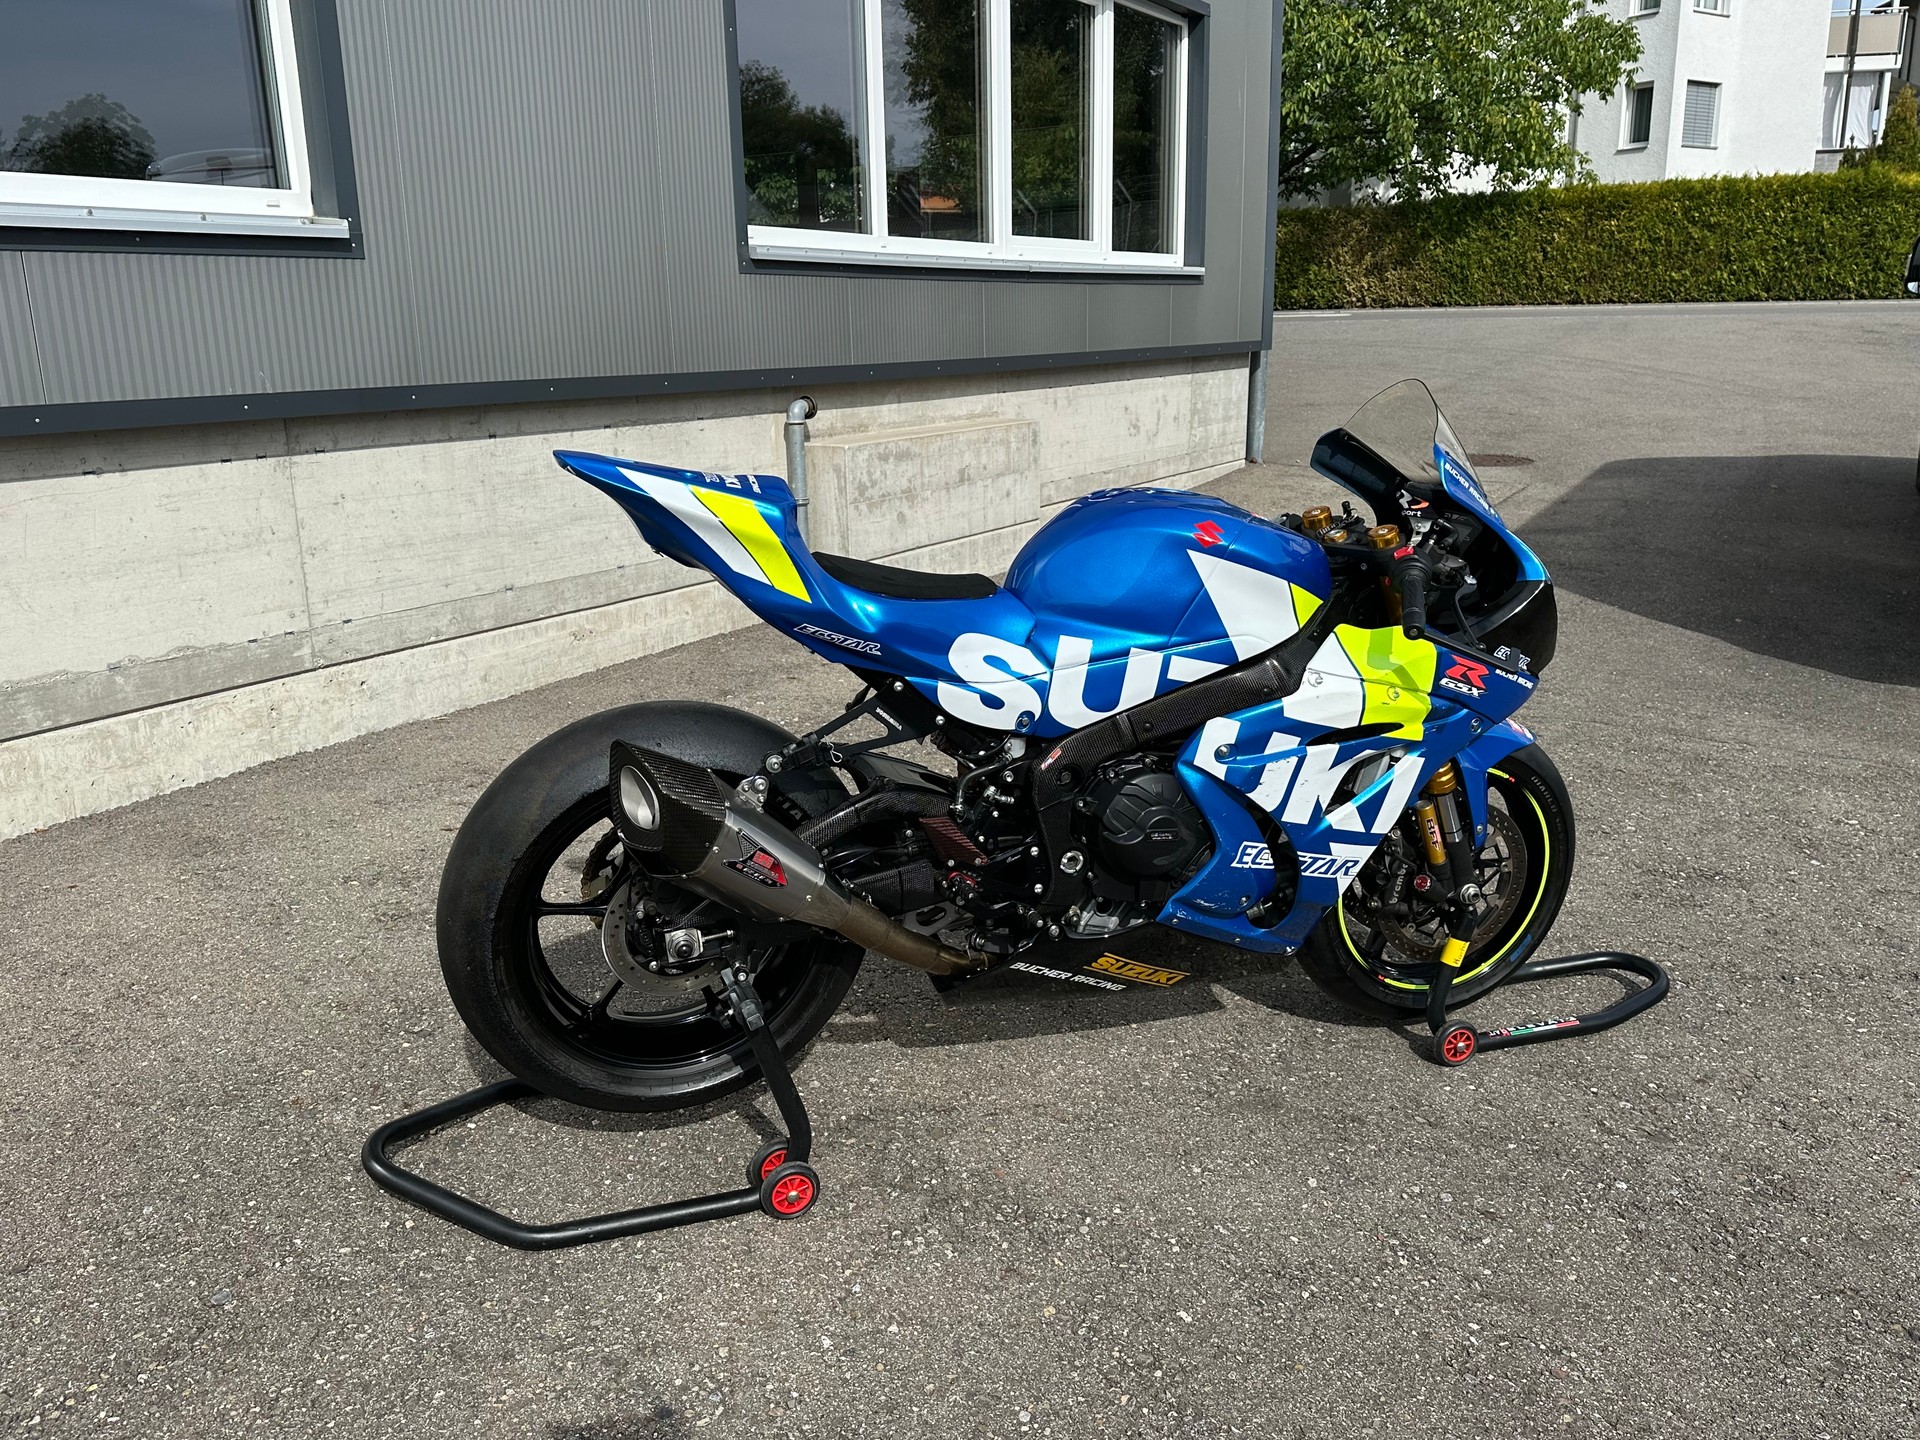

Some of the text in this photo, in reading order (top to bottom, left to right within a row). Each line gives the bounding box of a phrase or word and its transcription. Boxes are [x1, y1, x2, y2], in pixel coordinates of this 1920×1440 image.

[1444, 462, 1469, 489] BUCHER
[793, 623, 882, 656] ECSTAR
[1439, 677, 1487, 698] GSX
[1009, 961, 1127, 992] BUCHER RACING
[1091, 956, 1186, 985] SUZUKI
